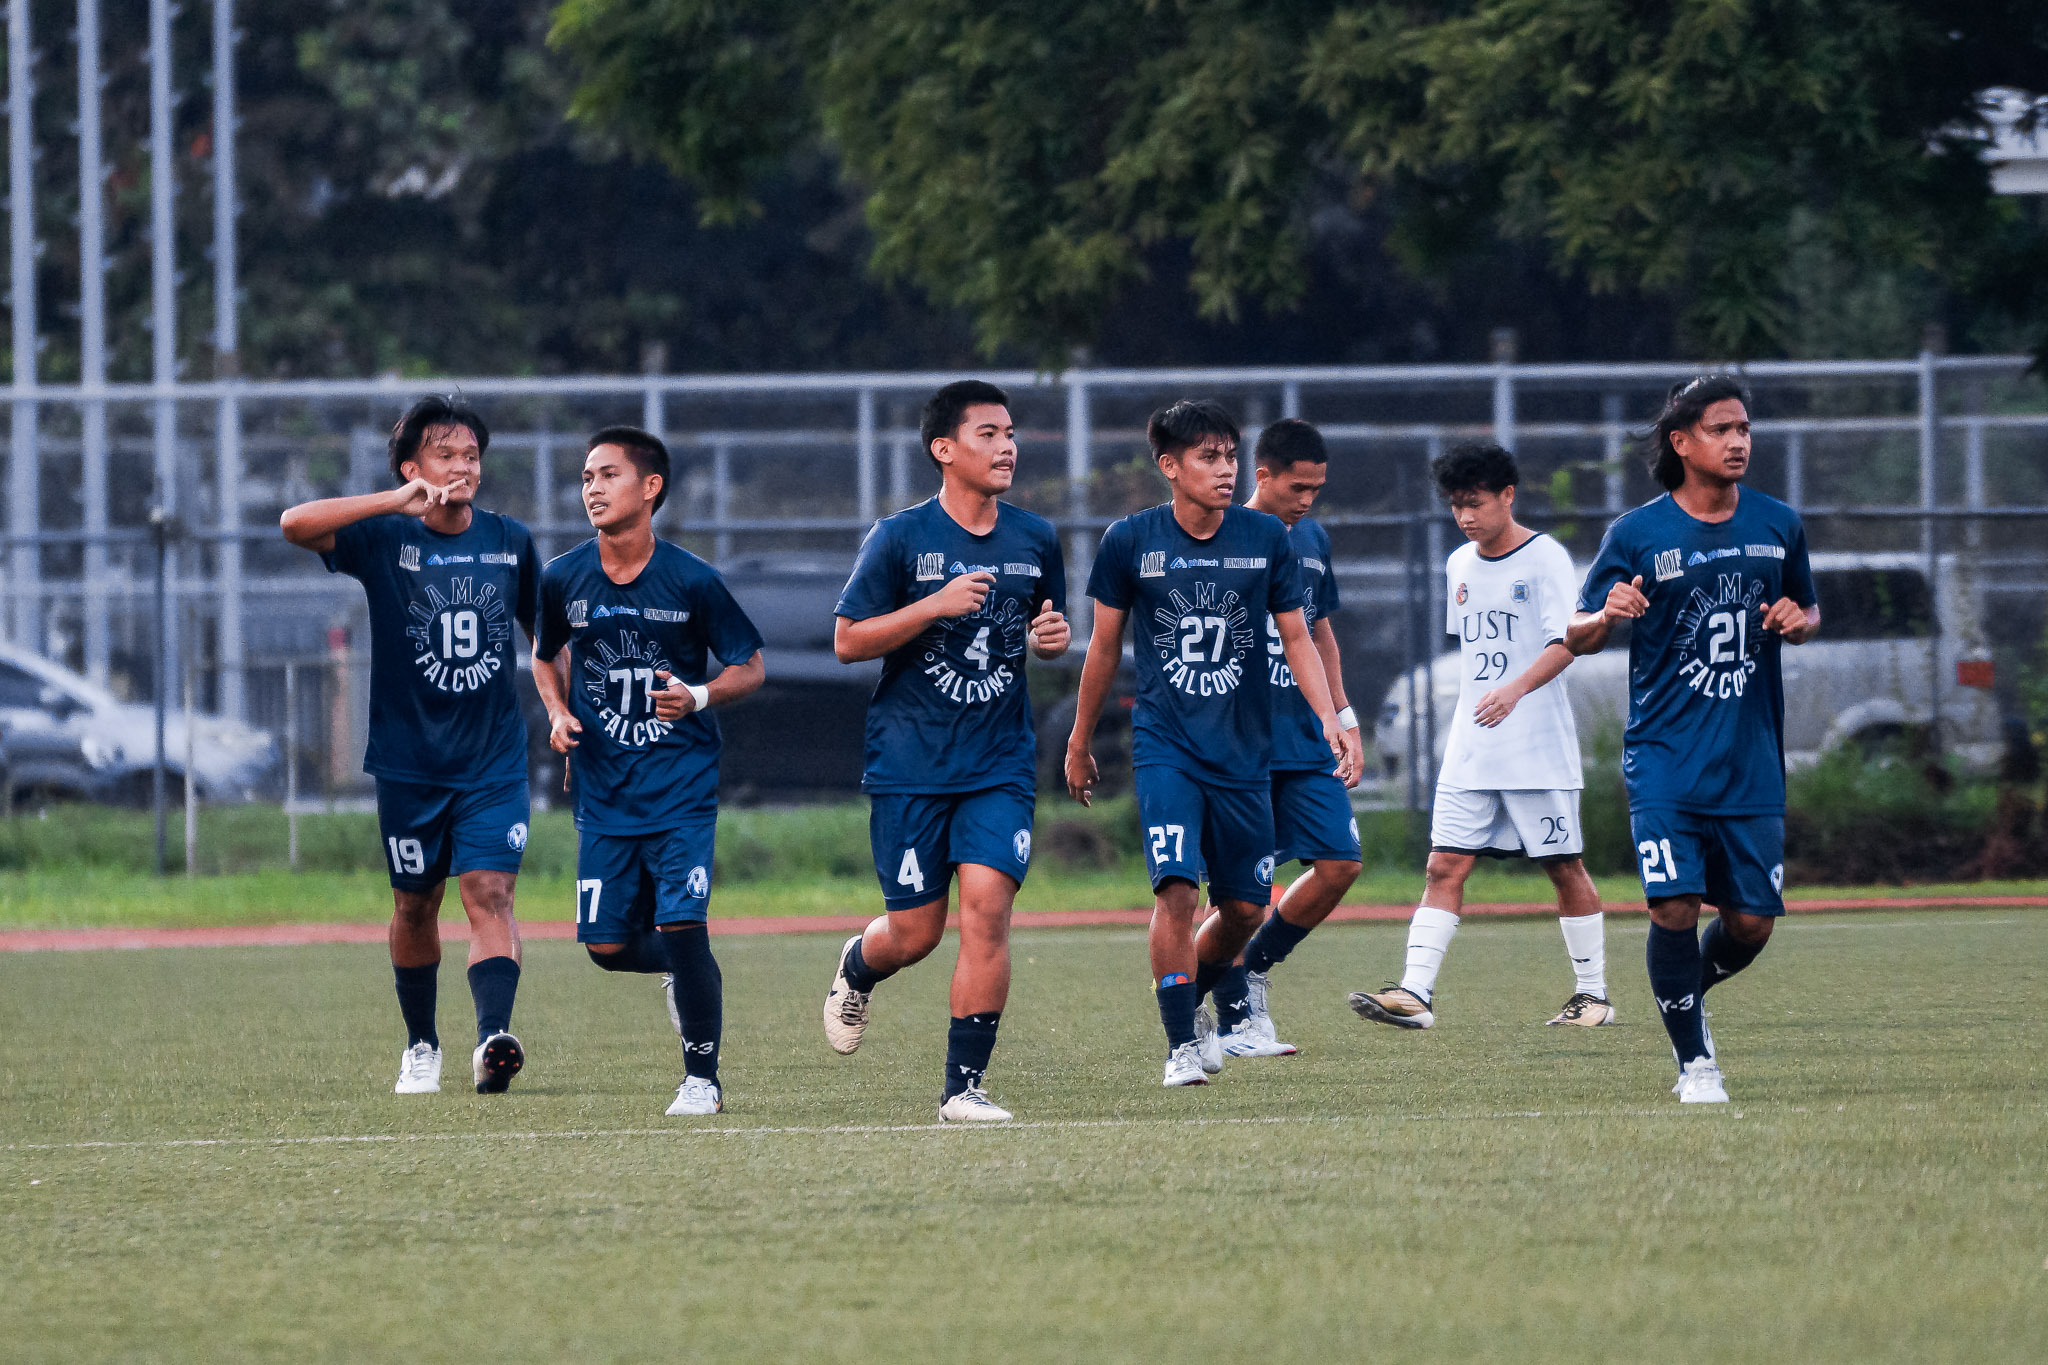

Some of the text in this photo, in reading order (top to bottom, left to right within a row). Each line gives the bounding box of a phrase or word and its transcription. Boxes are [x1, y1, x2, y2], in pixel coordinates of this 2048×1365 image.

[917, 553, 944, 576] AOF
[406, 576, 509, 645] ADAMSON
[1154, 581, 1253, 649] ADAMSON
[1462, 610, 1519, 643] UST
[440, 611, 478, 659] 19
[963, 626, 990, 671] 4
[1180, 616, 1226, 662] 27
[1708, 609, 1746, 664] 21
[415, 651, 501, 692] FALCONS
[924, 661, 1014, 704] FALCONS
[1162, 656, 1243, 697] FALCONS
[1473, 651, 1508, 681] 29
[608, 668, 654, 715] 77
[1149, 824, 1184, 866] 27
[1540, 816, 1569, 845] 29
[388, 836, 425, 874] 19
[897, 847, 924, 893] 4
[1638, 838, 1678, 884] 21
[1655, 993, 1694, 1014] Y-3
[681, 1036, 714, 1055] Y-3
